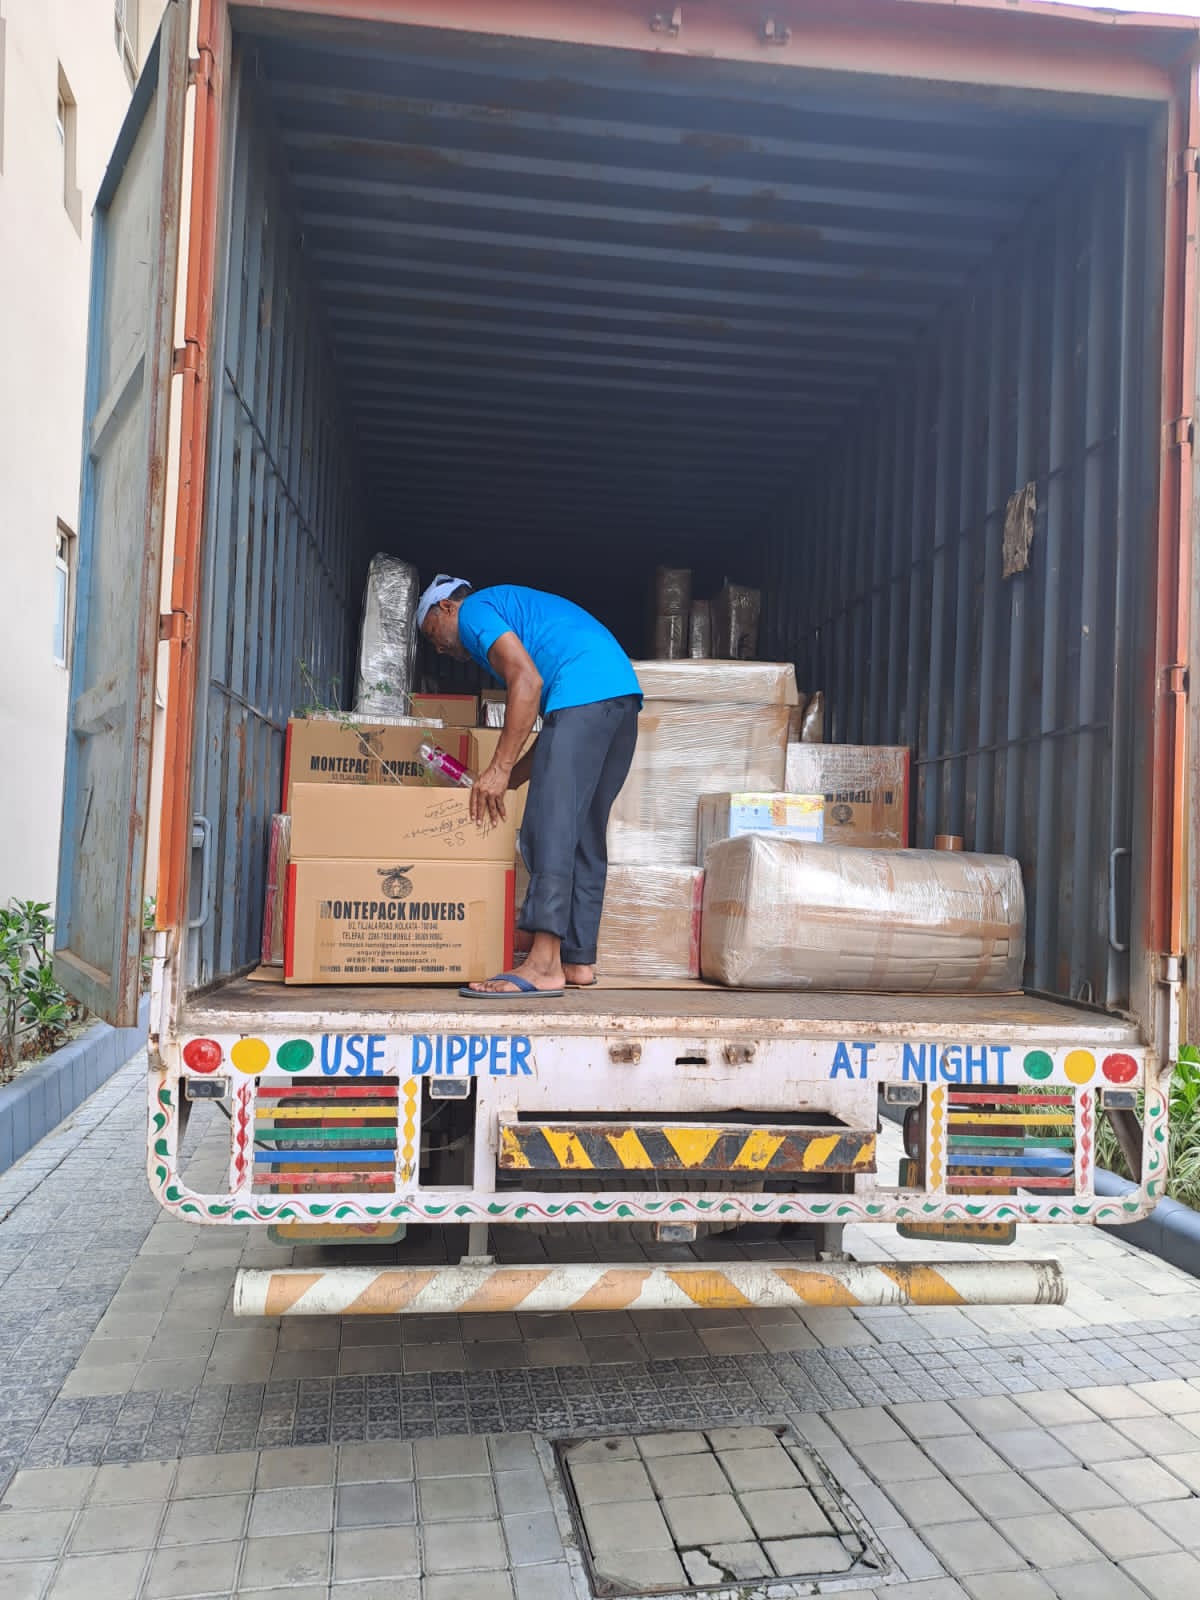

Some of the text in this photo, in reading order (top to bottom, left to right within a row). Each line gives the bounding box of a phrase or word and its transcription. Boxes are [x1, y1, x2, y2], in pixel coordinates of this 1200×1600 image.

[310, 755, 369, 773] MONTEPAC
[409, 902, 465, 921] MOVERS
[321, 1034, 533, 1076] USE DIPPER
[829, 1041, 1011, 1085] AT NIGHT
